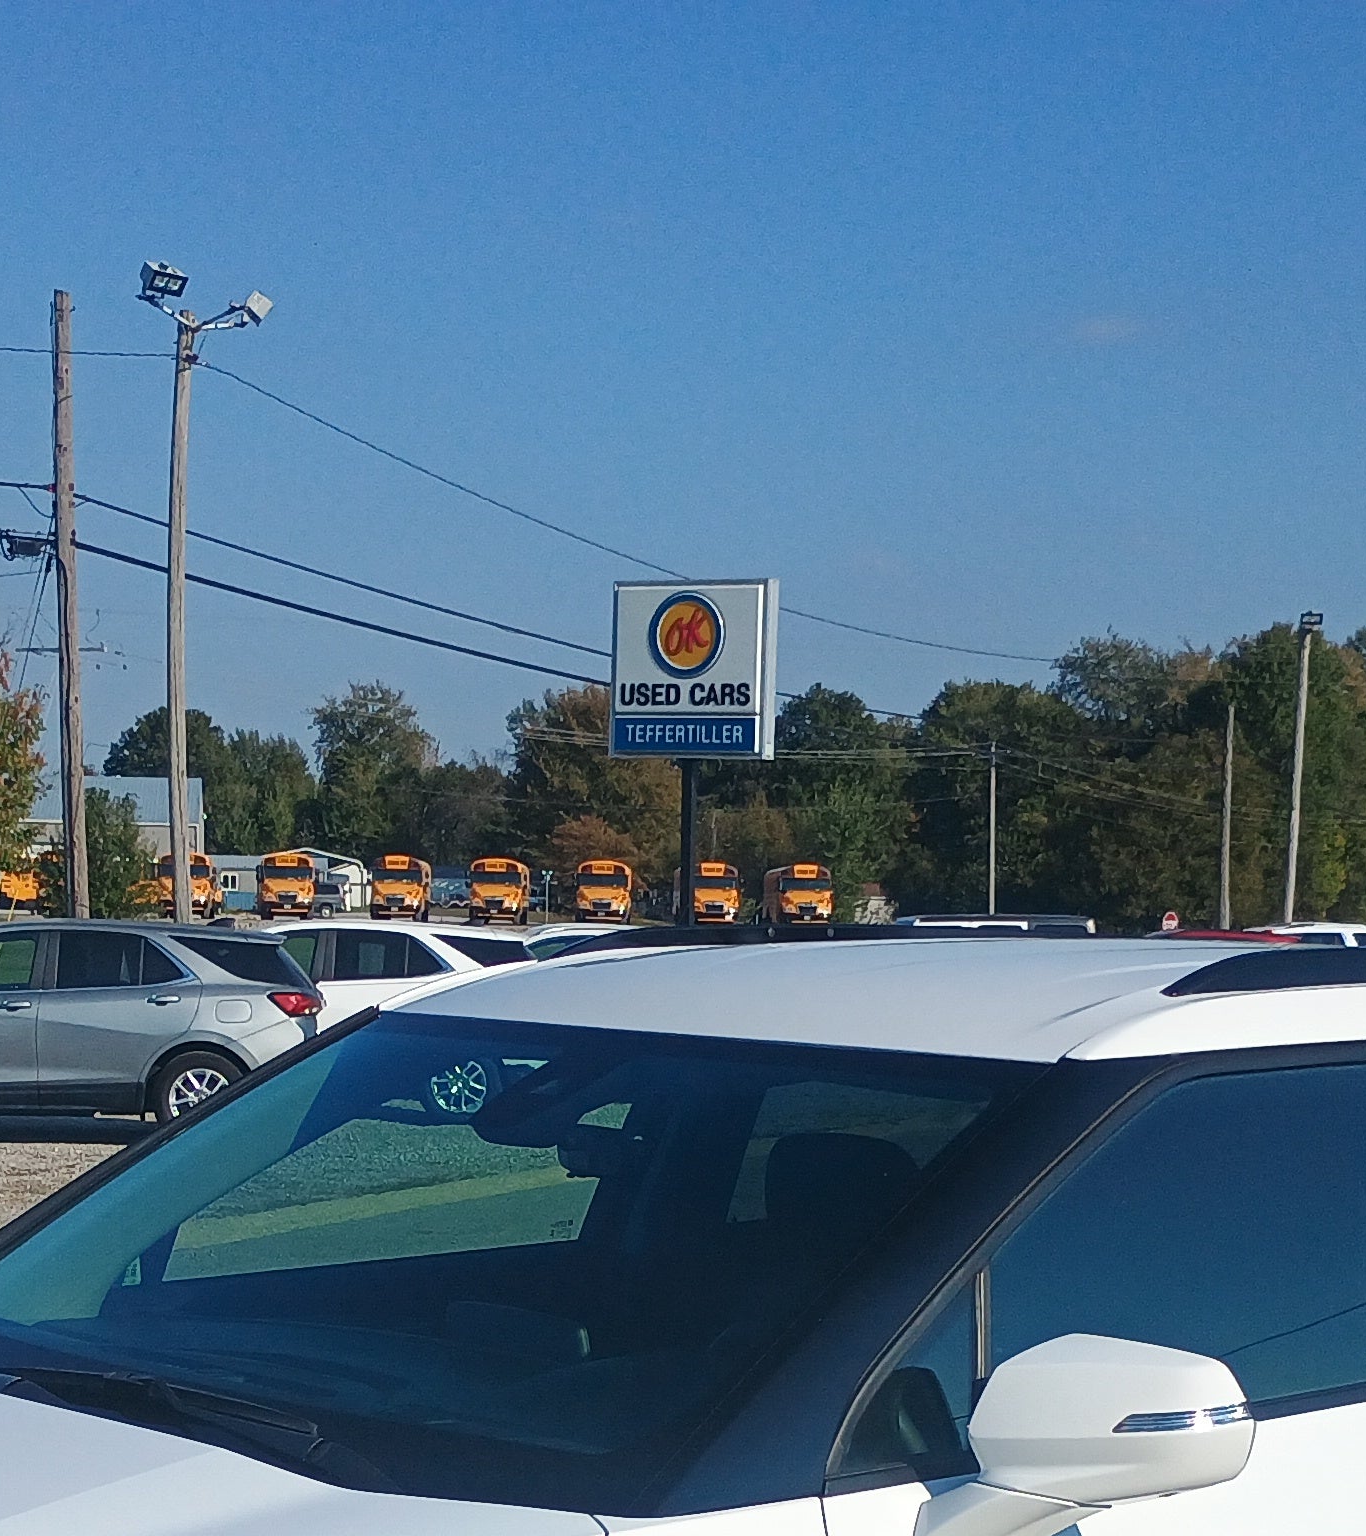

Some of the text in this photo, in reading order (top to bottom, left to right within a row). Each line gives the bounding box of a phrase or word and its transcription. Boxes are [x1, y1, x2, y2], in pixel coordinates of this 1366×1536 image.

[664, 606, 709, 657] OK
[620, 682, 751, 706] USED CARS
[625, 724, 743, 744] TEFFERTILLER
